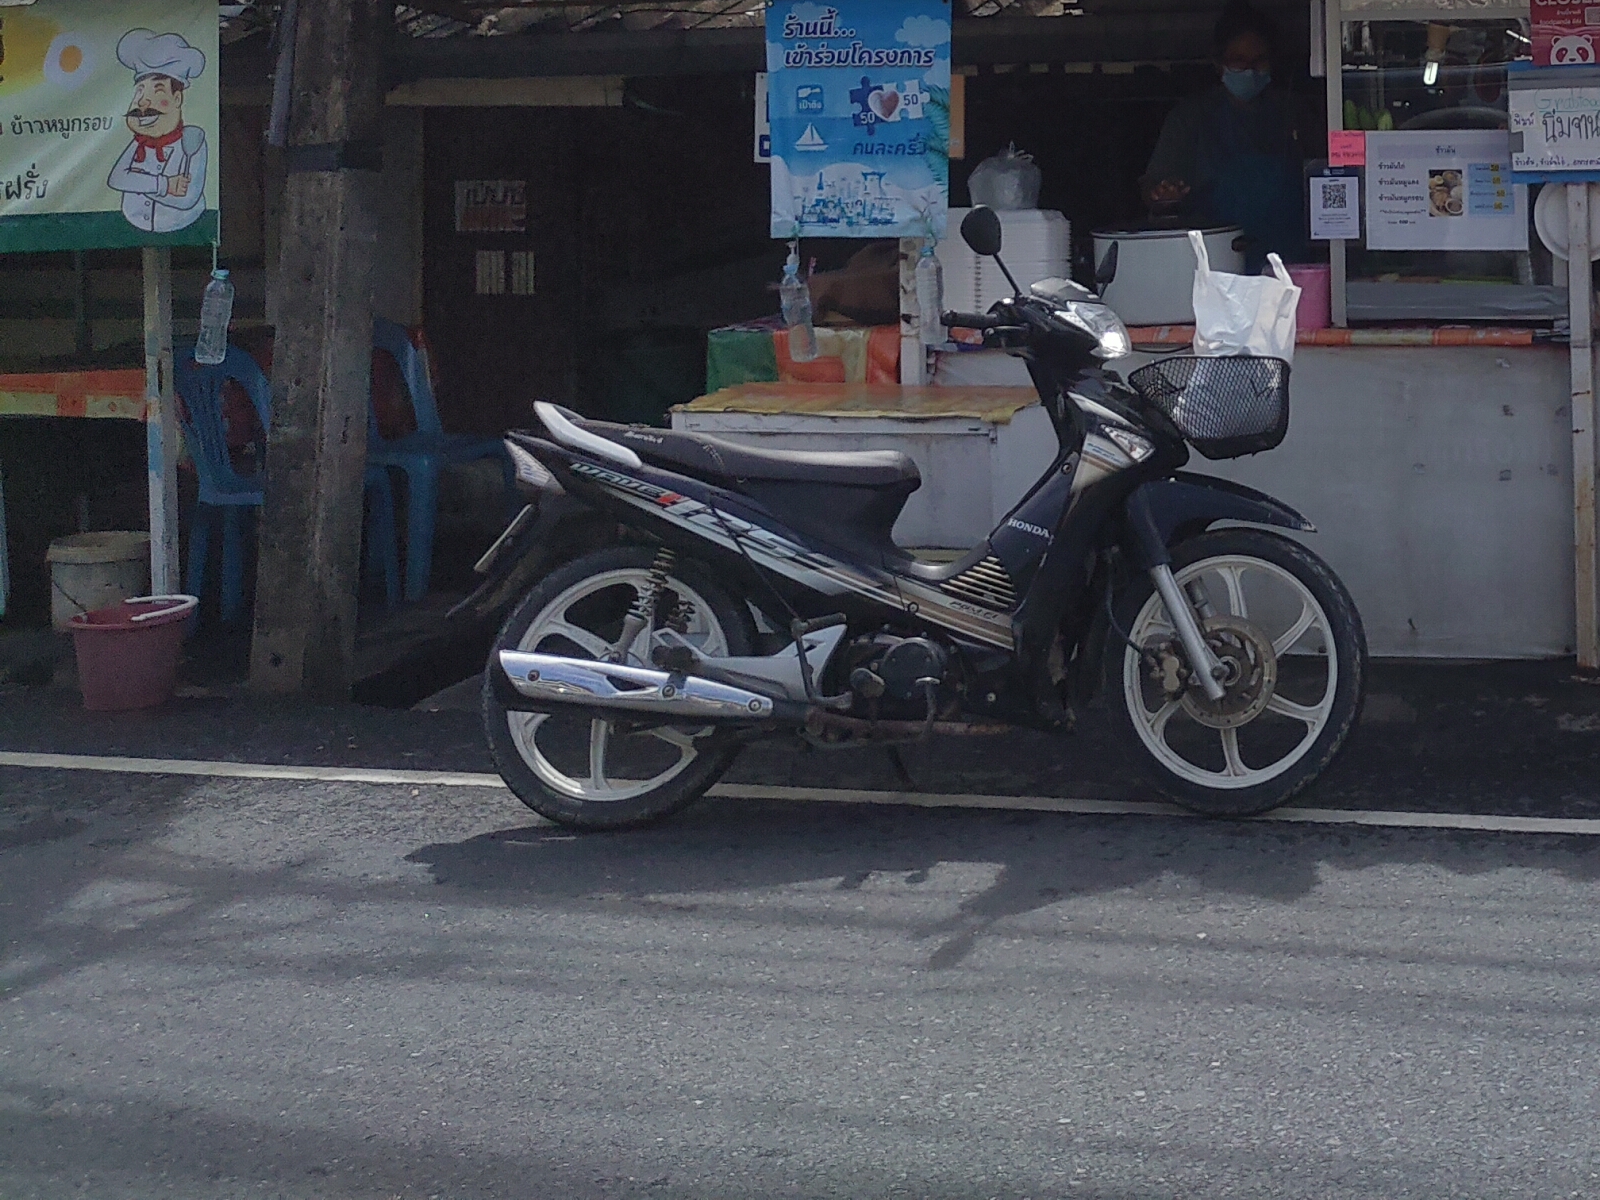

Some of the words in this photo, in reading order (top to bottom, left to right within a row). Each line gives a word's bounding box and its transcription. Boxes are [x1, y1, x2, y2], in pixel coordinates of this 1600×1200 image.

[784, 7, 856, 39] ร้านนี้...
[785, 42, 935, 68] เข้าร่วมโครงการ
[903, 94, 919, 106] 50
[11, 114, 113, 139] ข้าวหมูกรอบ
[860, 112, 875, 124] 50
[852, 133, 927, 157] คนละครึ่ง
[1007, 517, 1050, 539] HONDA
